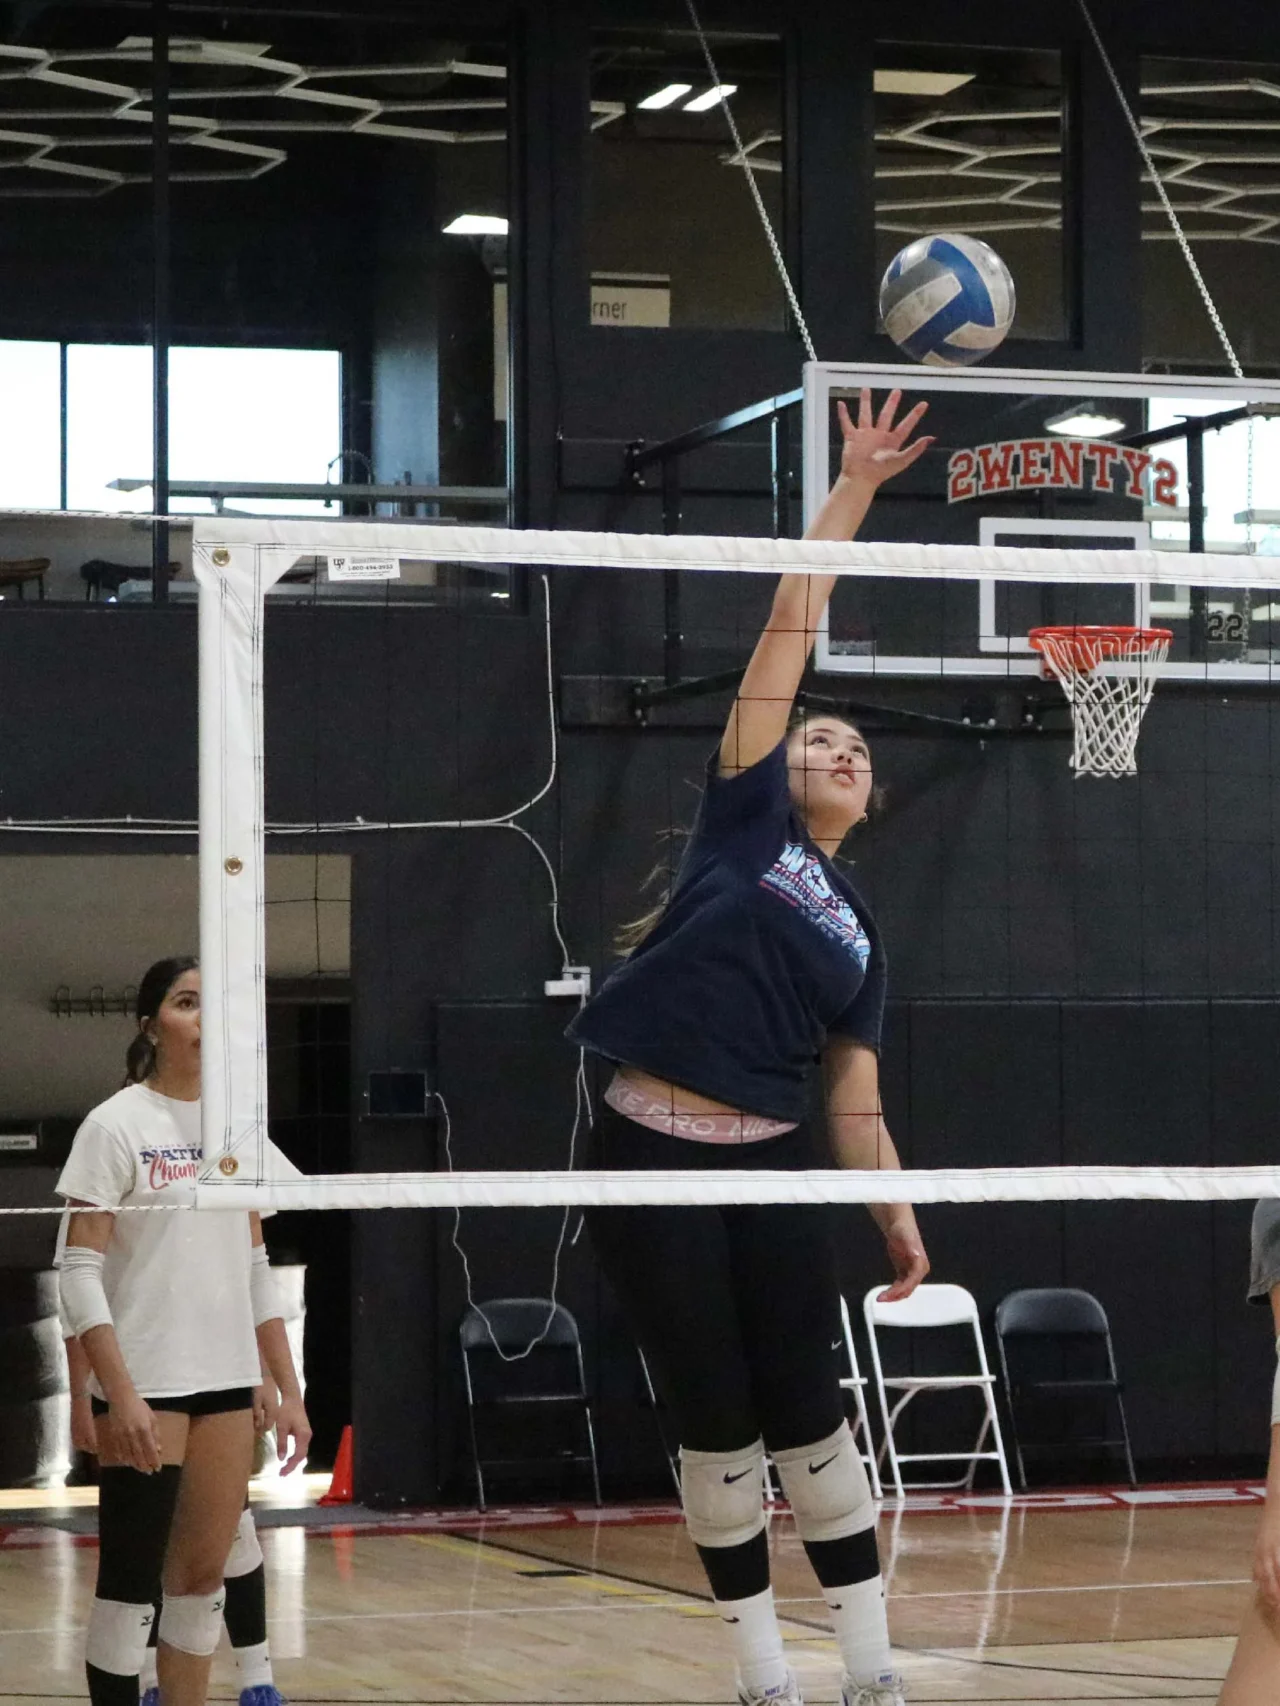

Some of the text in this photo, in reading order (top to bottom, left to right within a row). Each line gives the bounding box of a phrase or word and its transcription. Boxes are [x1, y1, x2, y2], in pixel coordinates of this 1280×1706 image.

[592, 302, 627, 320] rner
[948, 436, 1179, 509] 2WENTY2
[1208, 614, 1244, 642] 22
[645, 1104, 716, 1135] PRO
[149, 1153, 199, 1190] Cham
